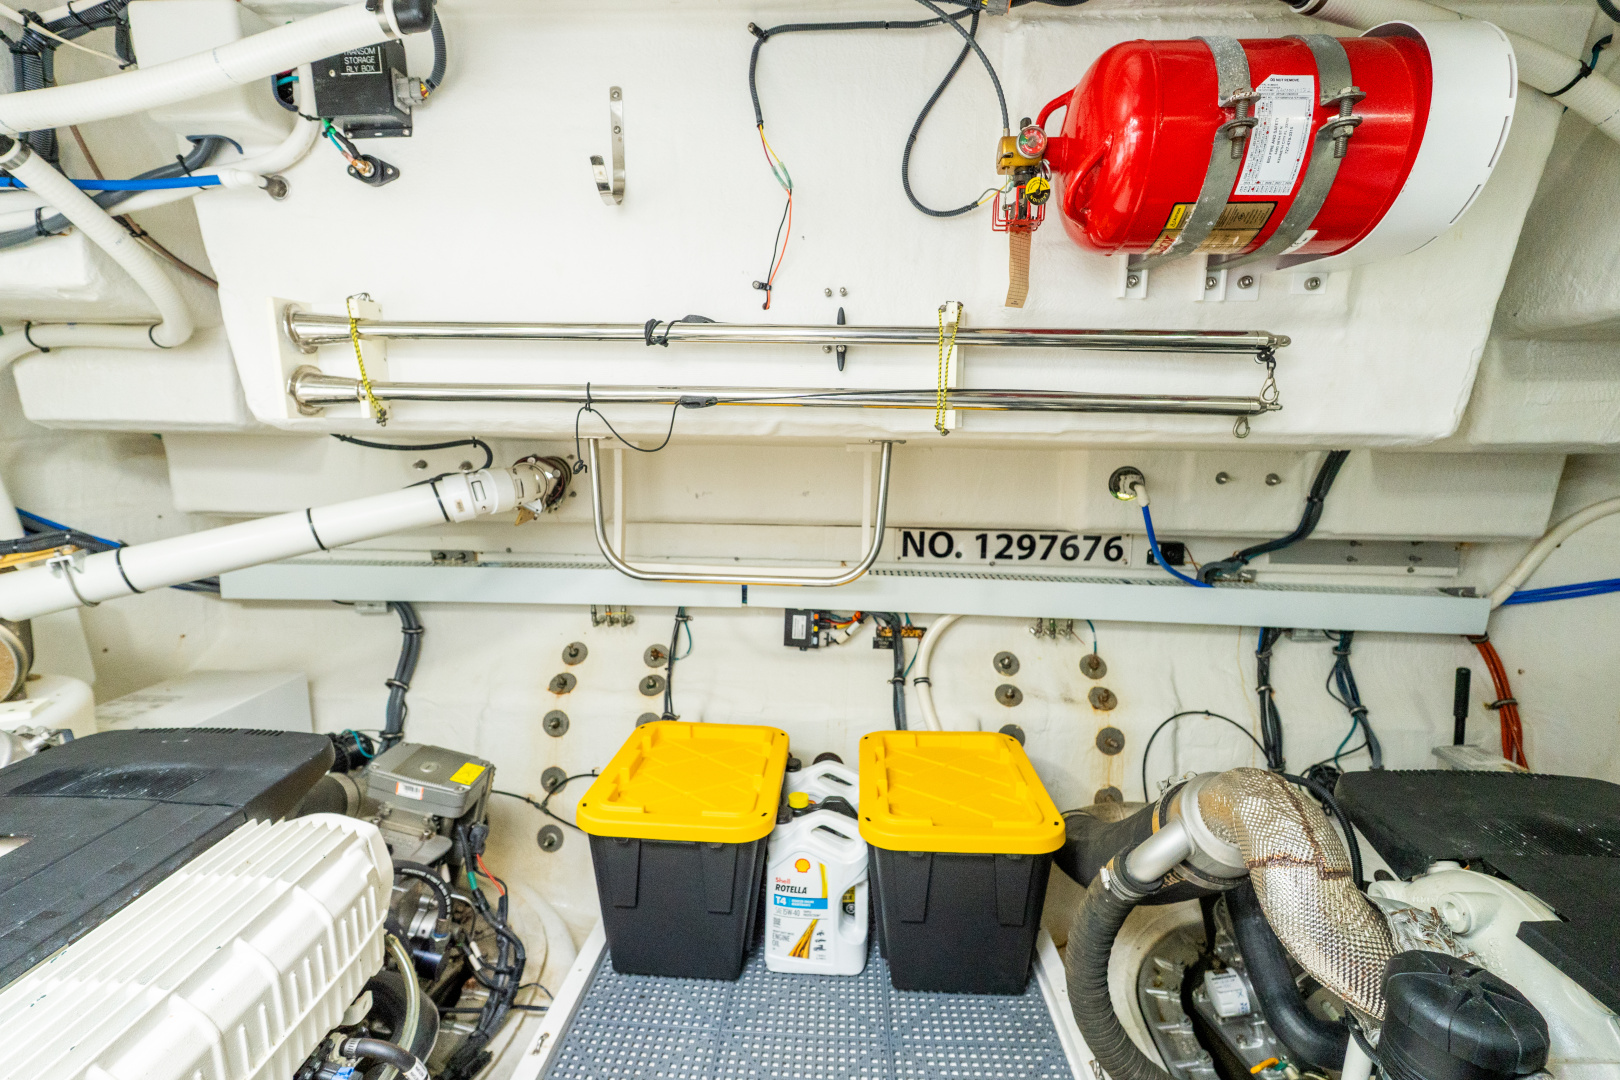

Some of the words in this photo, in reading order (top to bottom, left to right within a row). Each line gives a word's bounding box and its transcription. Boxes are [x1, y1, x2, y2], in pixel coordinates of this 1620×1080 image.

[344, 56, 376, 64] STORAGE
[346, 65, 359, 73] RLY
[902, 530, 963, 559] NO.
[975, 532, 1124, 562] 1297676
[775, 884, 807, 894] ROTELLA
[775, 895, 787, 906] T4
